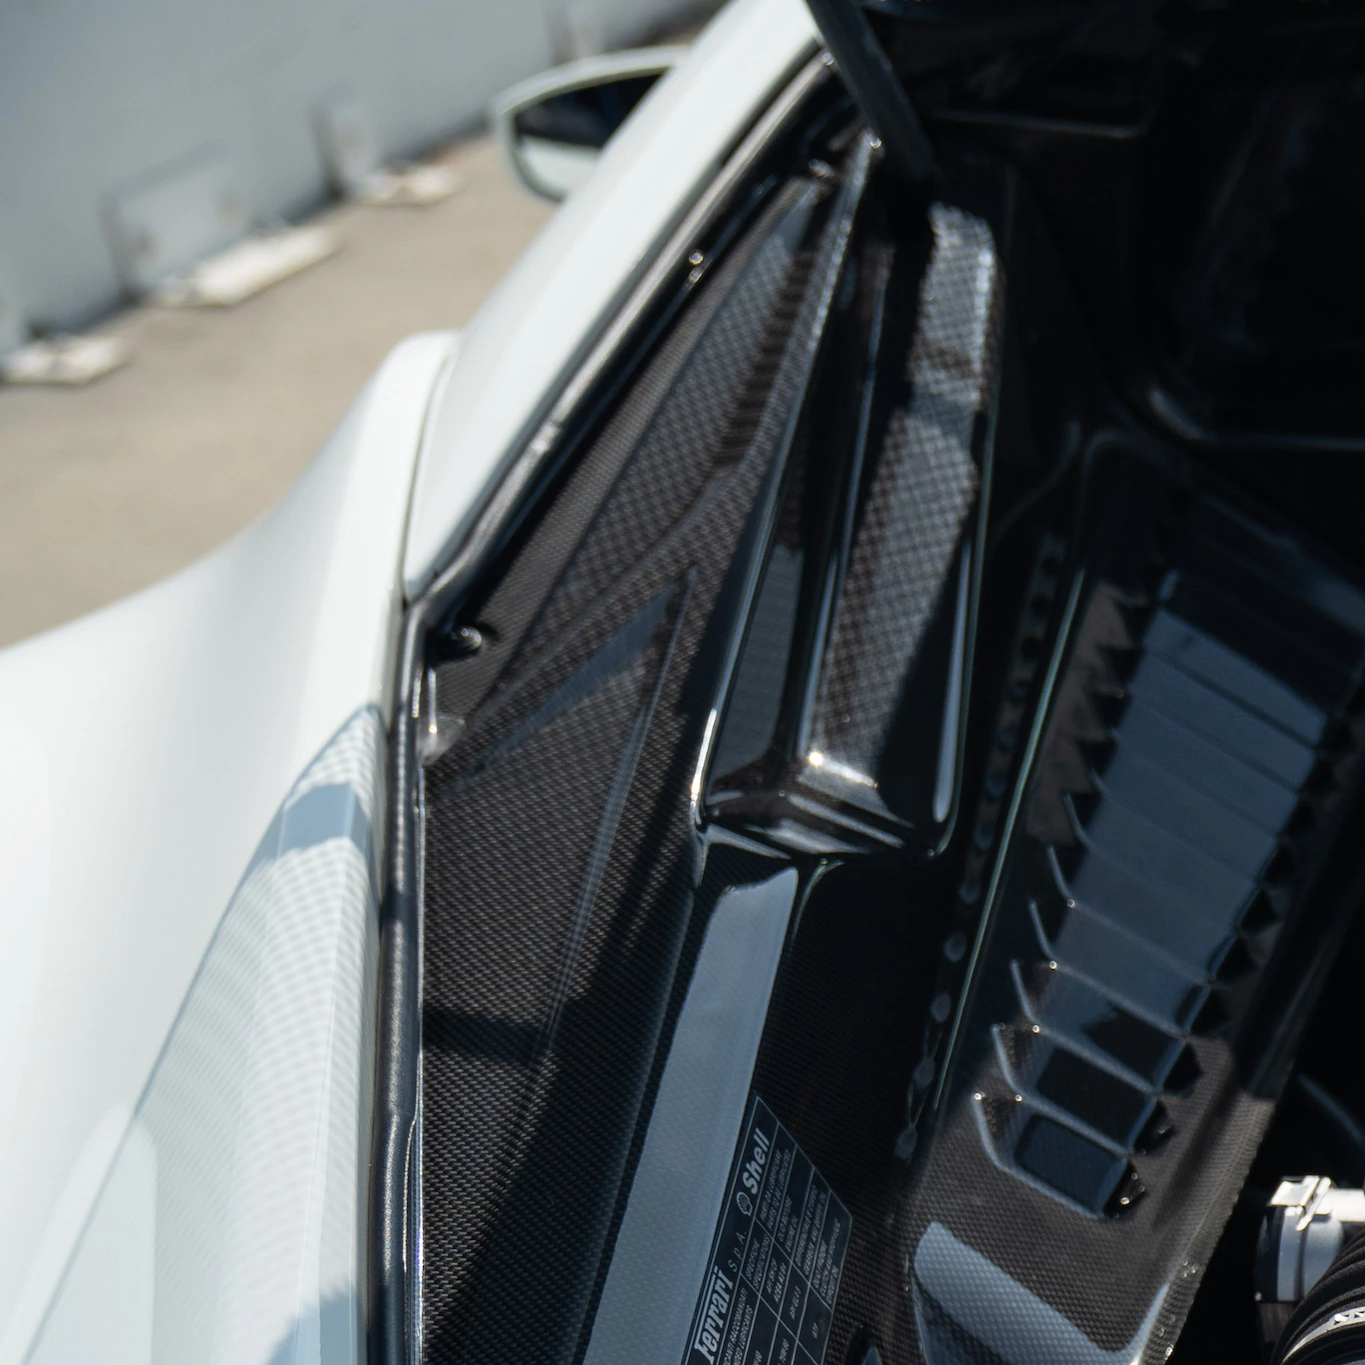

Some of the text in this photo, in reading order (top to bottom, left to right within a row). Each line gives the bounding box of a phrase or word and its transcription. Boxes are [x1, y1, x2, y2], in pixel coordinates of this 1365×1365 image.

[743, 1128, 769, 1194] Shell
[768, 1207, 777, 1230] PARTS
[753, 1234, 770, 1289] SPECIFICATIONS
[695, 1267, 732, 1364] Ferrari
[730, 1288, 747, 1344] RACCOMANDATI
[739, 1305, 753, 1349] LUBRICANTS
